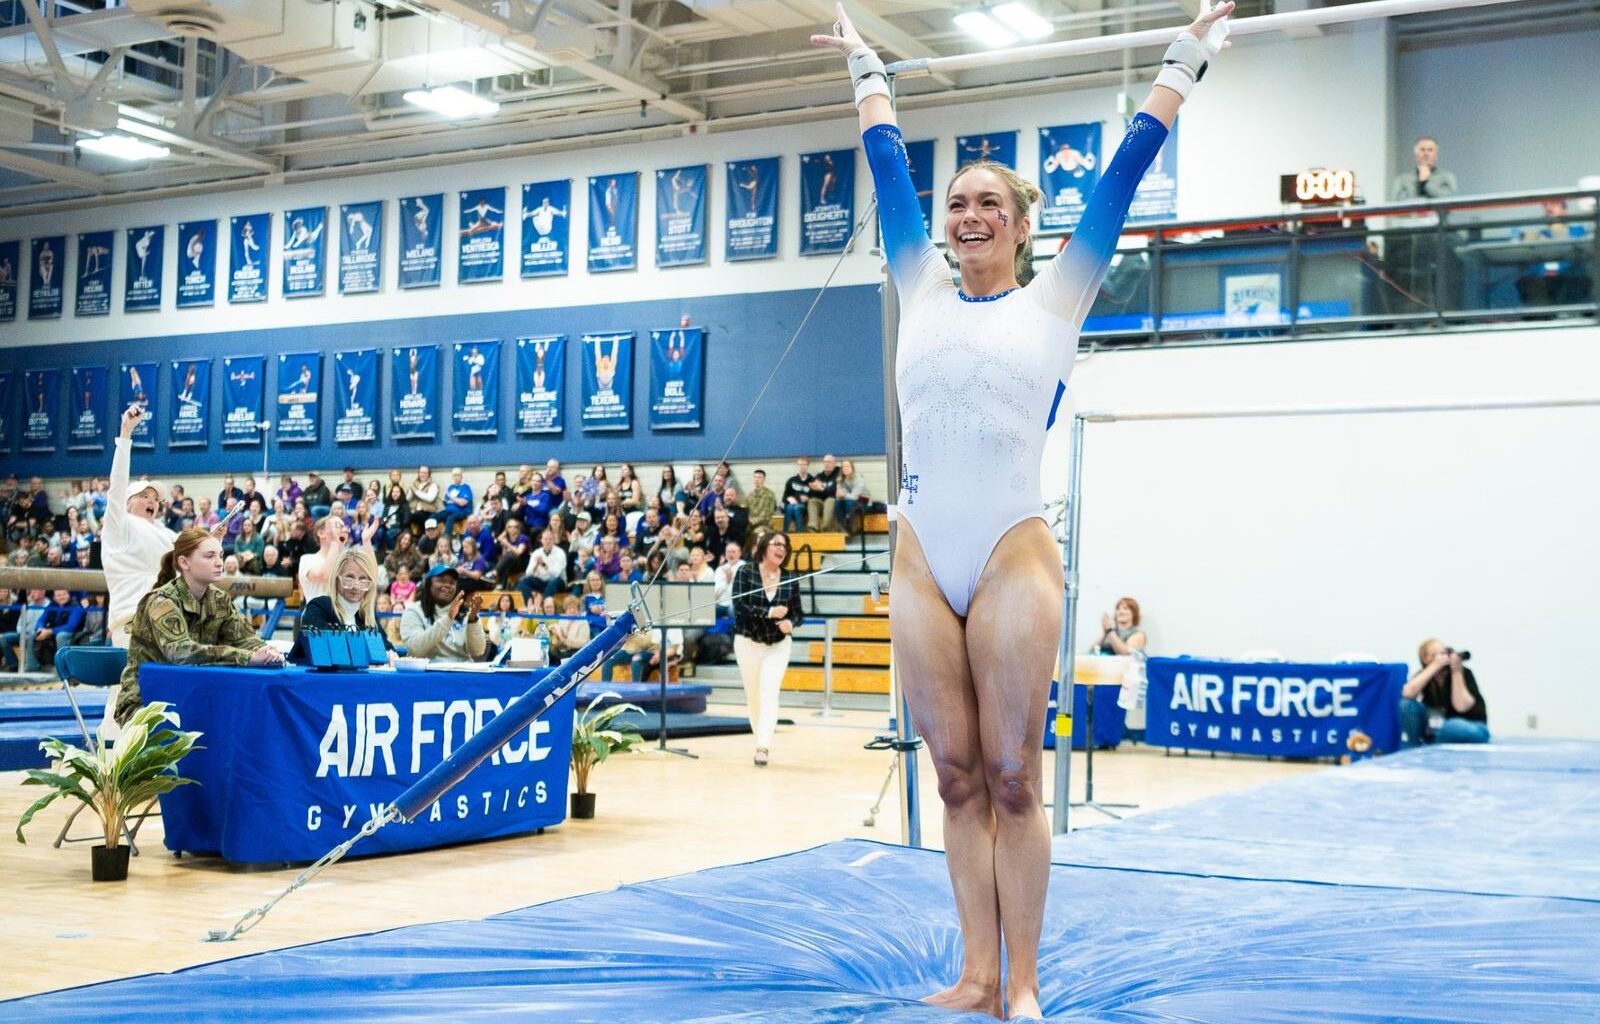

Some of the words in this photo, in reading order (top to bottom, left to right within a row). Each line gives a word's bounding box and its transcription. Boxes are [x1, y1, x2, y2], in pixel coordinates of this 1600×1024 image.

[1296, 170, 1354, 201] 0:00
[1169, 672, 1225, 714] AIR
[1231, 675, 1360, 718] FORCE
[315, 703, 399, 778] AIR
[1169, 720, 1339, 744] GYMNASTIC
[307, 780, 549, 831] GYMASTICS
